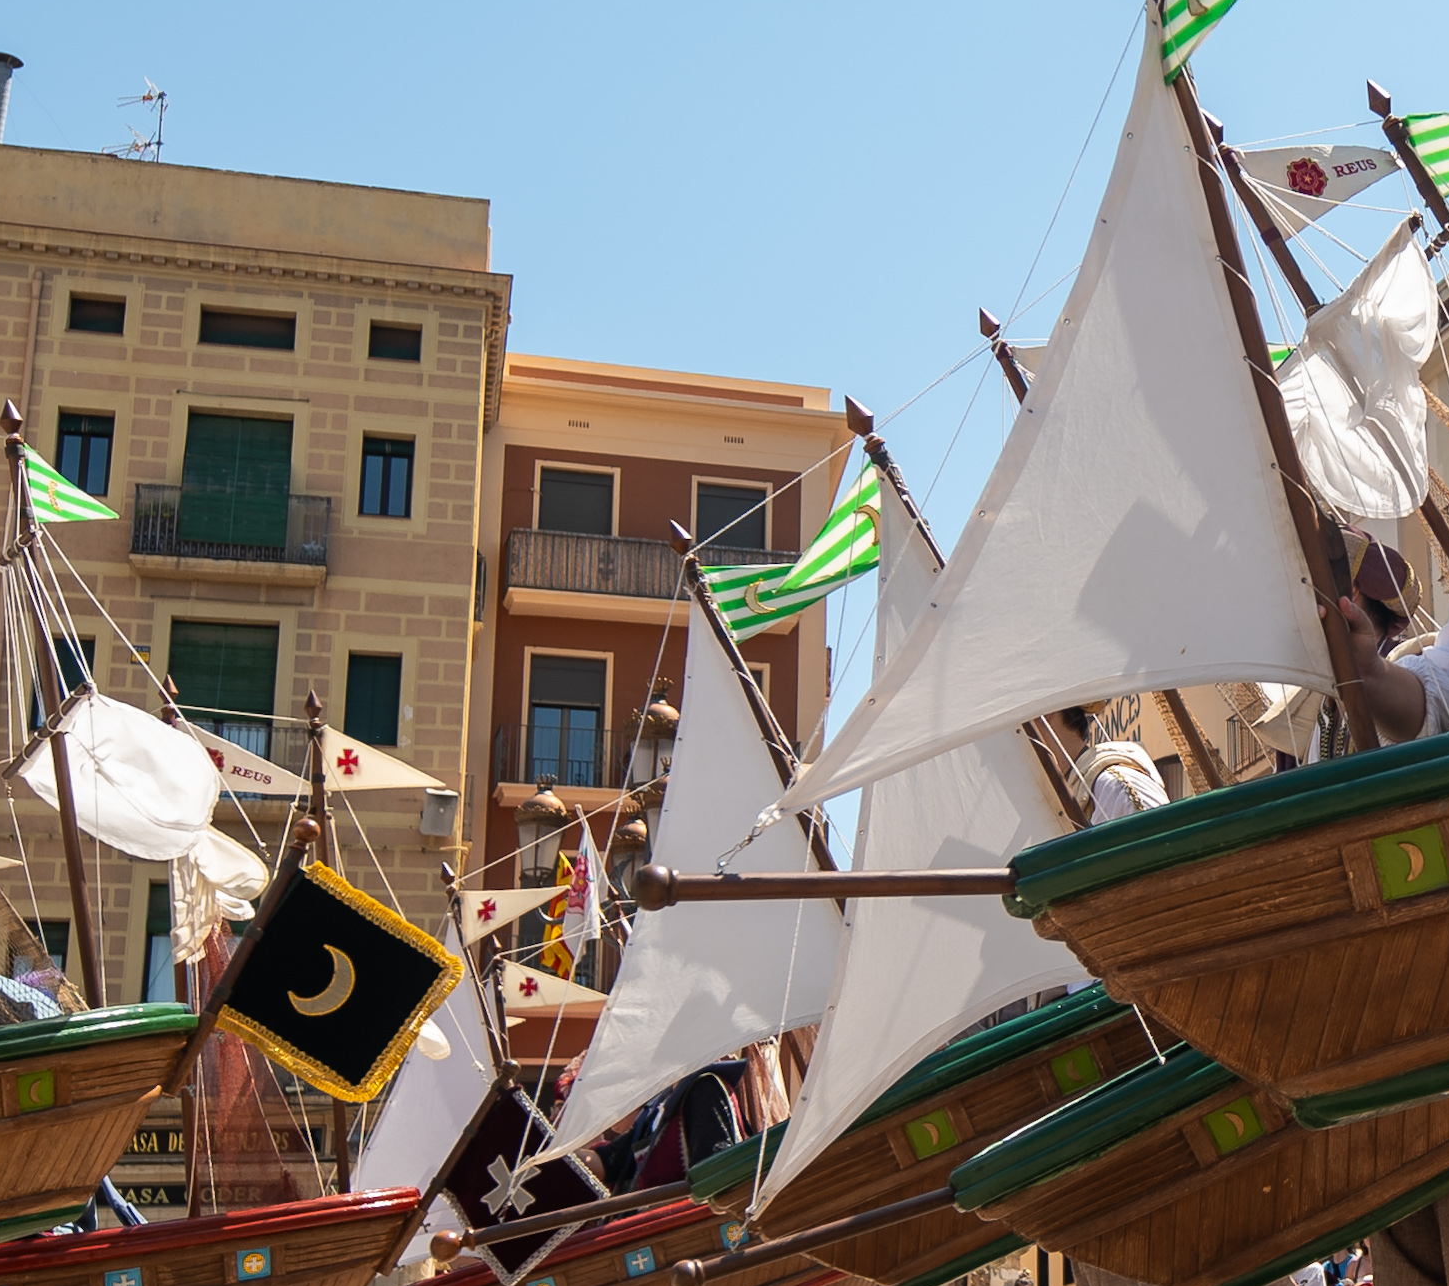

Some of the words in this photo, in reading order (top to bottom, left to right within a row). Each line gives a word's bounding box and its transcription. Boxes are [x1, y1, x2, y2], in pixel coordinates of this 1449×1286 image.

[1332, 158, 1377, 178] REUS
[230, 765, 272, 785] REUS
[127, 1132, 159, 1153] ASA
[121, 1188, 170, 1204] ASA
